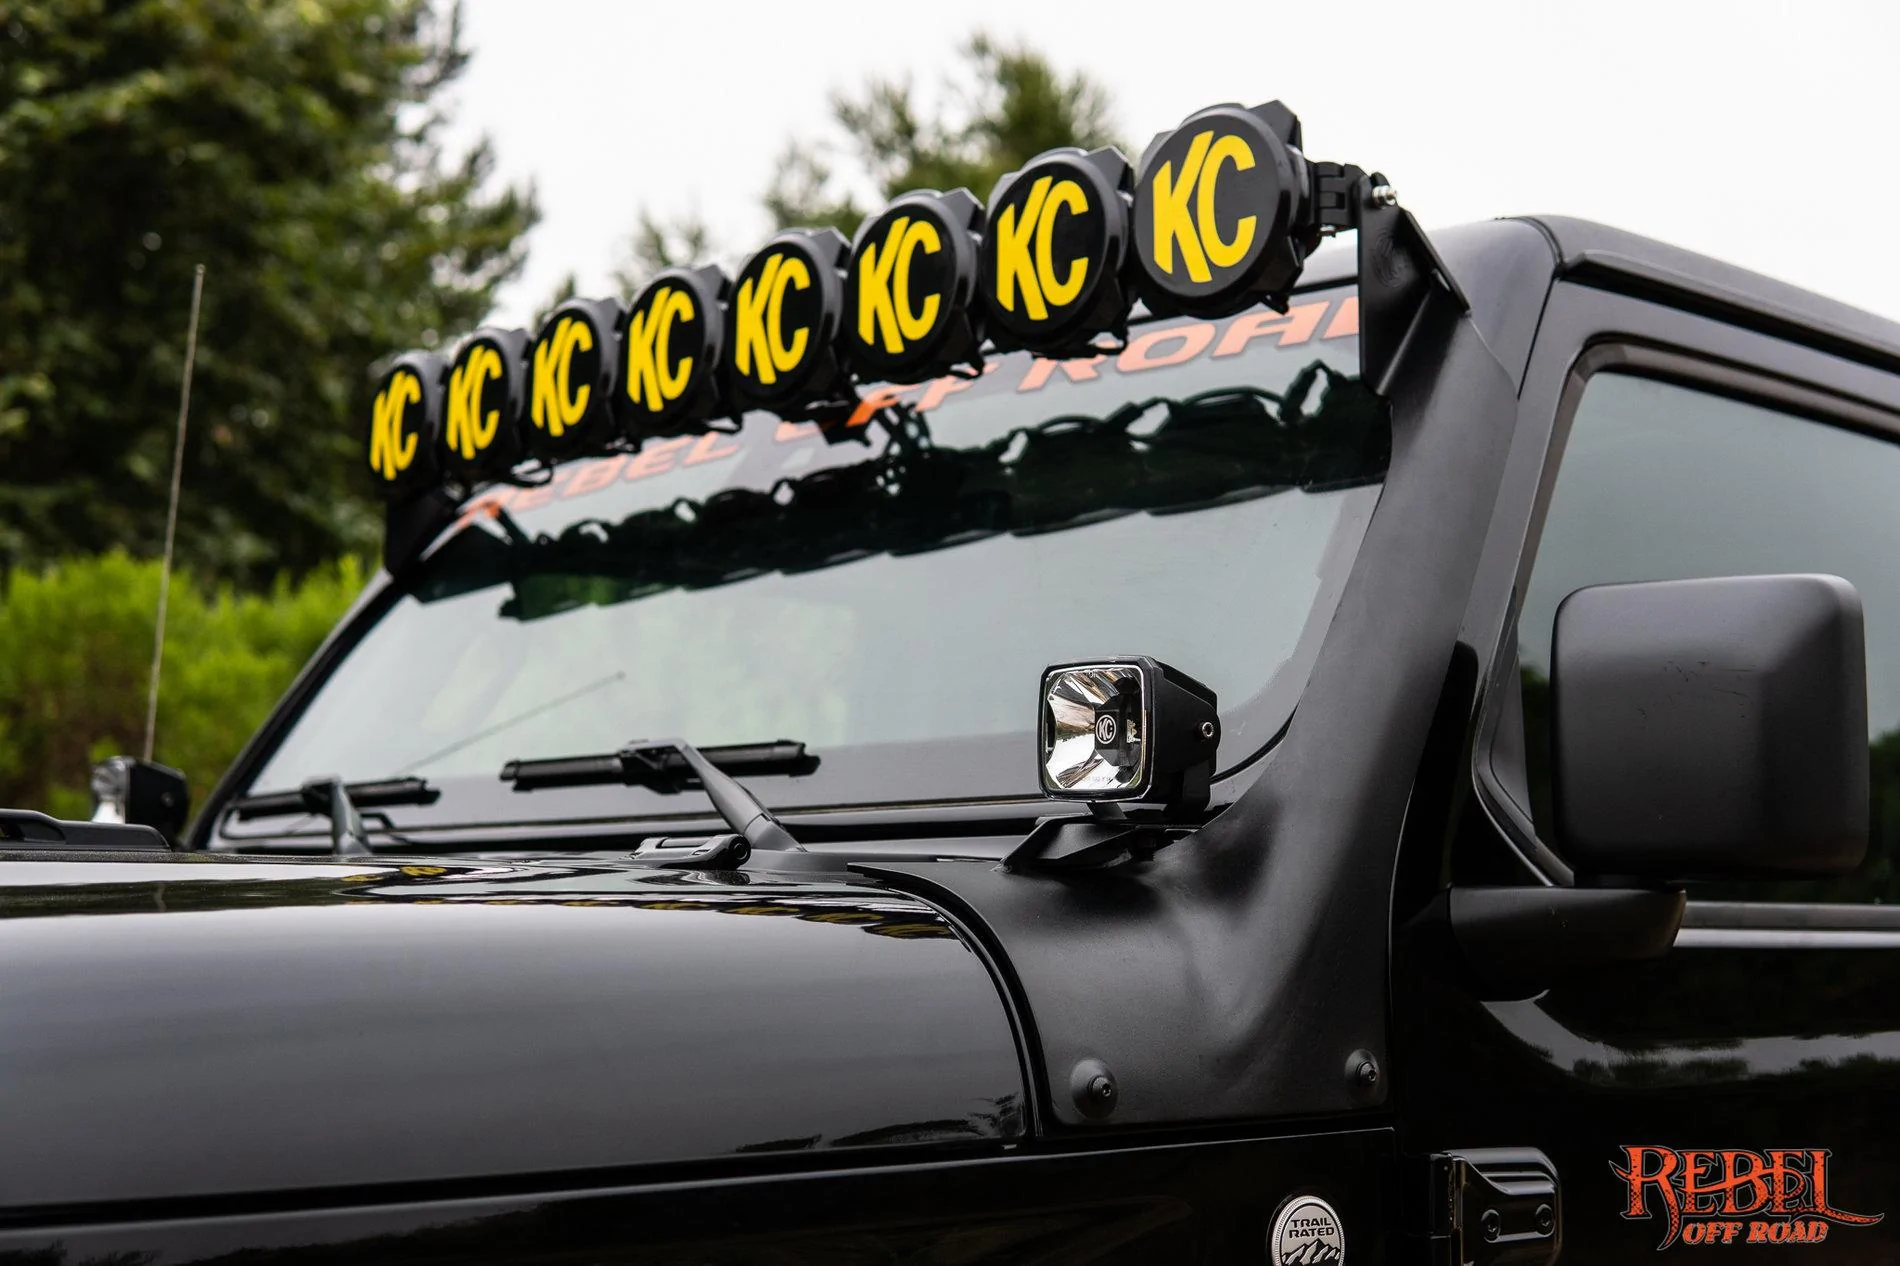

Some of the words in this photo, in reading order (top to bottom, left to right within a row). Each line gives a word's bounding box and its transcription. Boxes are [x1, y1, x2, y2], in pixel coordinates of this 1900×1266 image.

[996, 175, 1089, 321] KC
[1152, 131, 1257, 284] KC
[735, 253, 811, 385] KC
[858, 216, 942, 354] KC
[446, 345, 502, 460] KC
[531, 317, 593, 437] KC
[627, 286, 695, 412] KC
[370, 371, 421, 480] KC
[1098, 717, 1114, 741] KC
[1289, 1227, 1335, 1238] RATED
[1291, 1218, 1331, 1228] TRAIL
